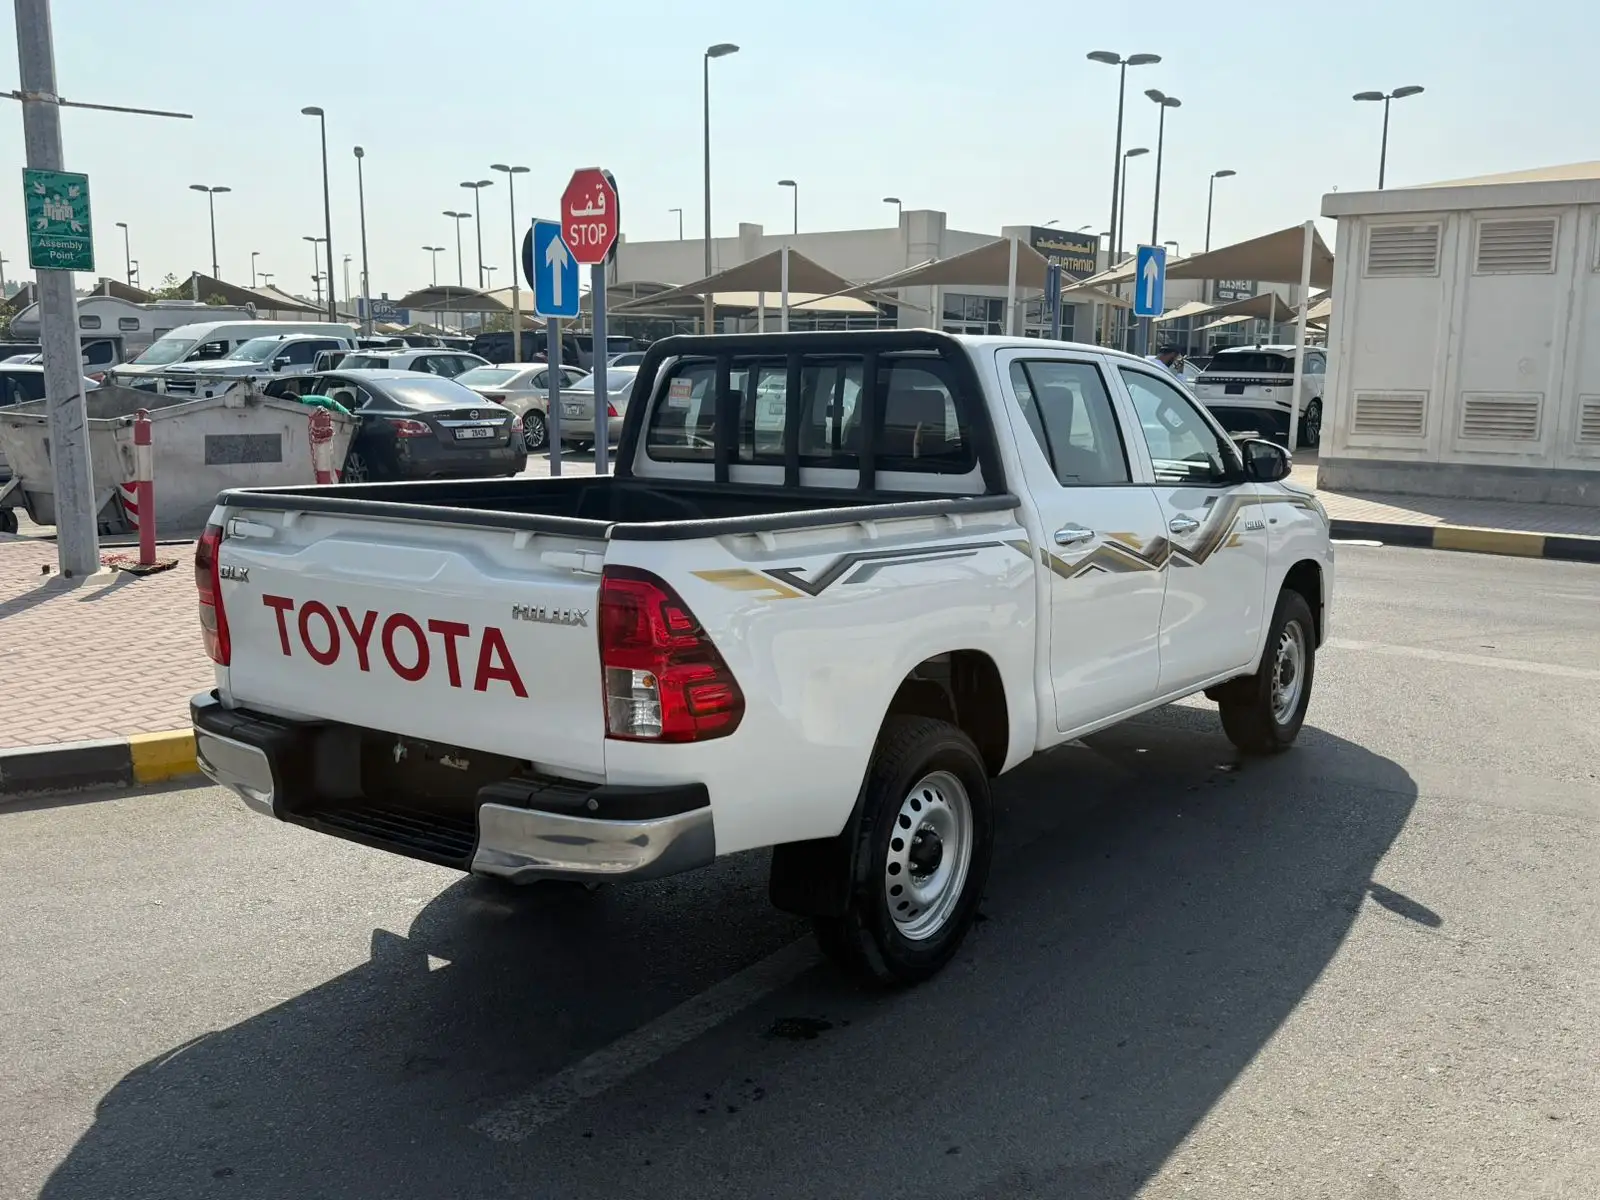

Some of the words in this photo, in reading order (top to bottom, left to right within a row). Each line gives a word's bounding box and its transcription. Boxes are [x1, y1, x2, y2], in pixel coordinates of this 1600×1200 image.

[570, 183, 606, 217] قف
[39, 238, 83, 251] Assembly
[570, 223, 608, 246] STOP
[50, 250, 74, 260] Point
[512, 602, 592, 628] HILUX
[262, 594, 529, 698] TOYOTA
